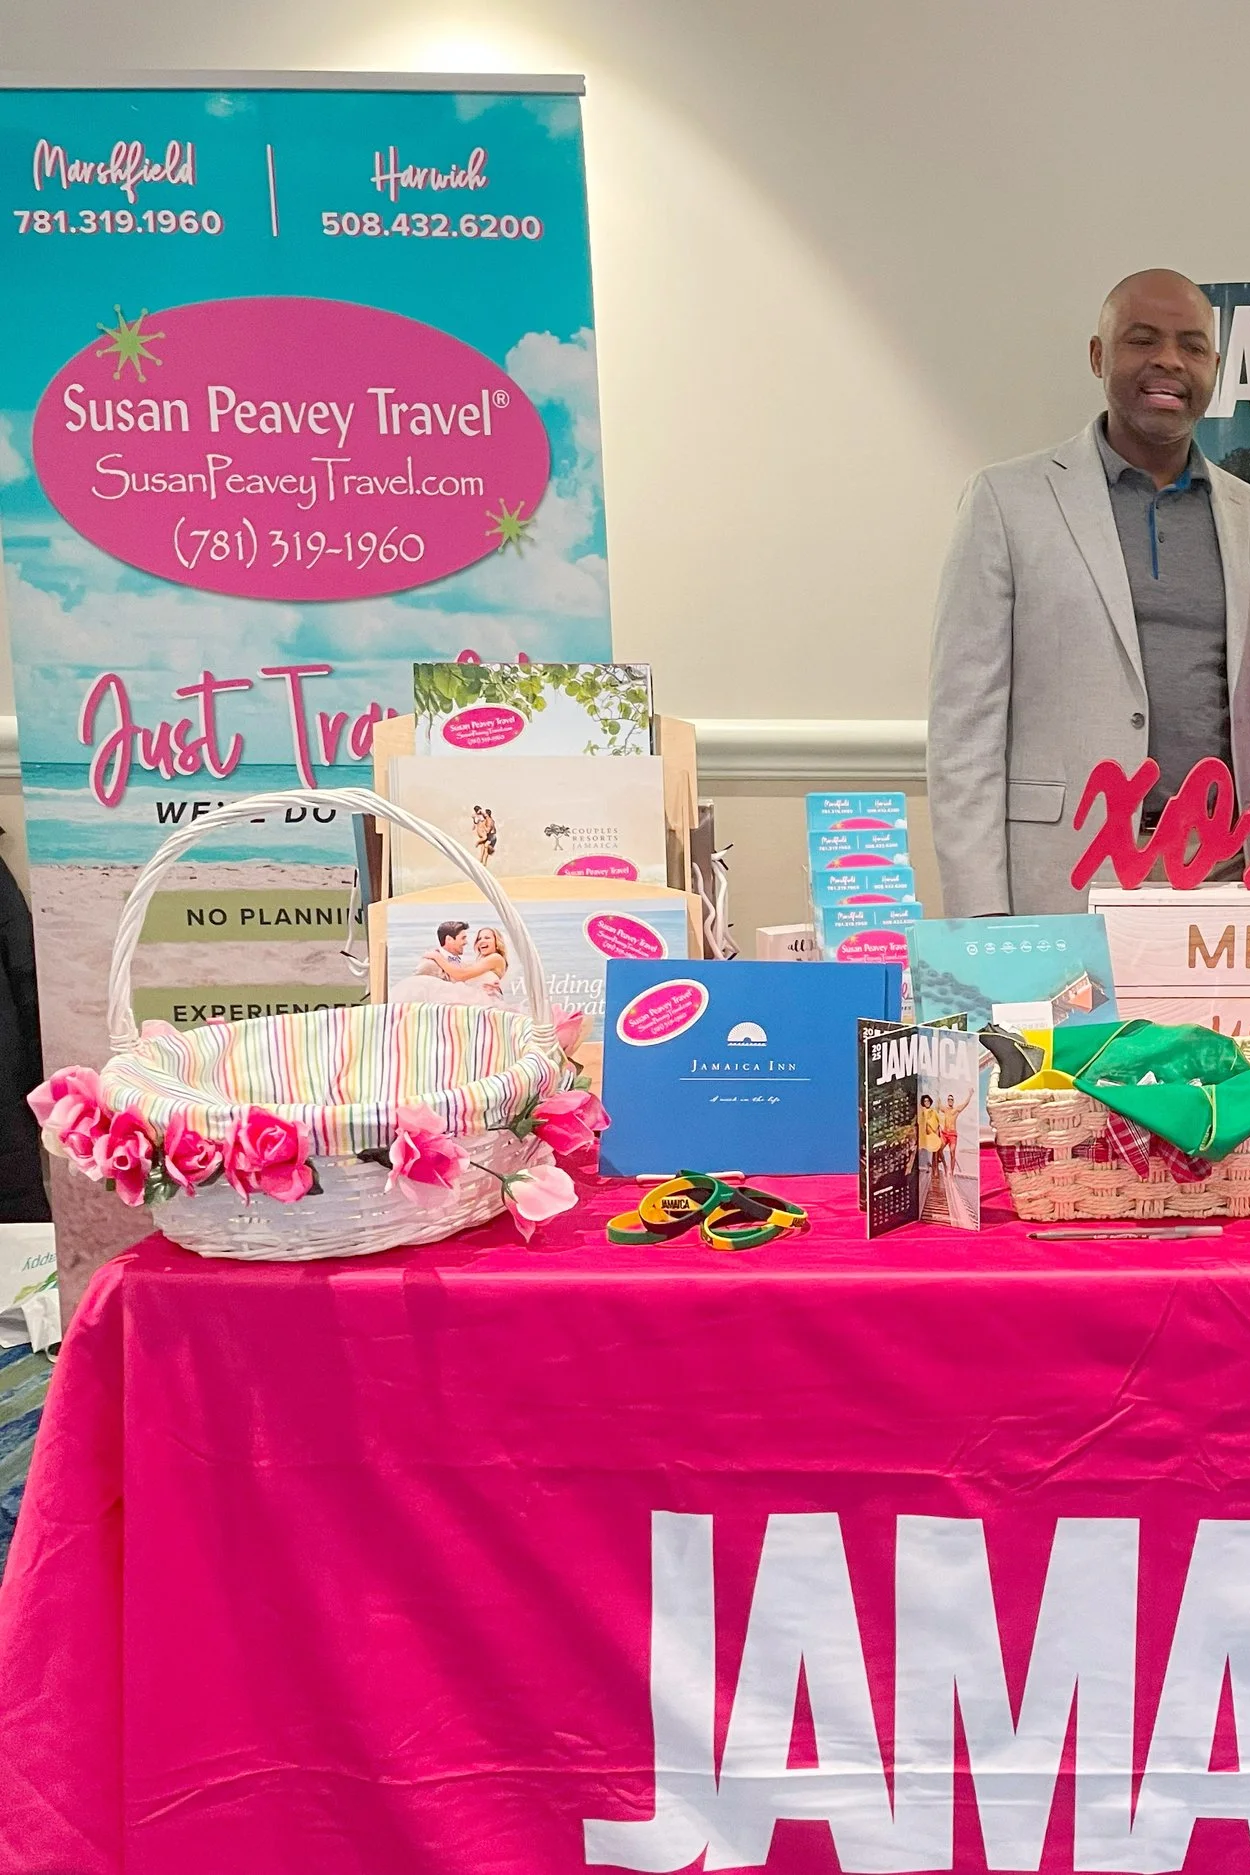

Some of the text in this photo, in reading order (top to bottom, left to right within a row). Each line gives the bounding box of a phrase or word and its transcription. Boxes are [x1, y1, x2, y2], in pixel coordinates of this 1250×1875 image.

[33, 138, 195, 204] Marshfield
[370, 146, 488, 203] Harwich
[13, 209, 224, 236] 781.319.1960
[321, 212, 544, 240] 508.432.6200
[63, 383, 190, 434] Susan
[208, 386, 354, 449] Peavey
[91, 453, 485, 510] SusanPeaveyTravel.com
[173, 516, 425, 570] (781) 319-1960
[78, 664, 398, 809] Just Tra
[186, 908, 228, 927] NO
[510, 973, 604, 999] Wdding
[871, 1043, 882, 1053] 20
[871, 1052, 882, 1062] 25
[876, 1034, 972, 1086] JAMAICA
[661, 1199, 690, 1210] JAMAICA
